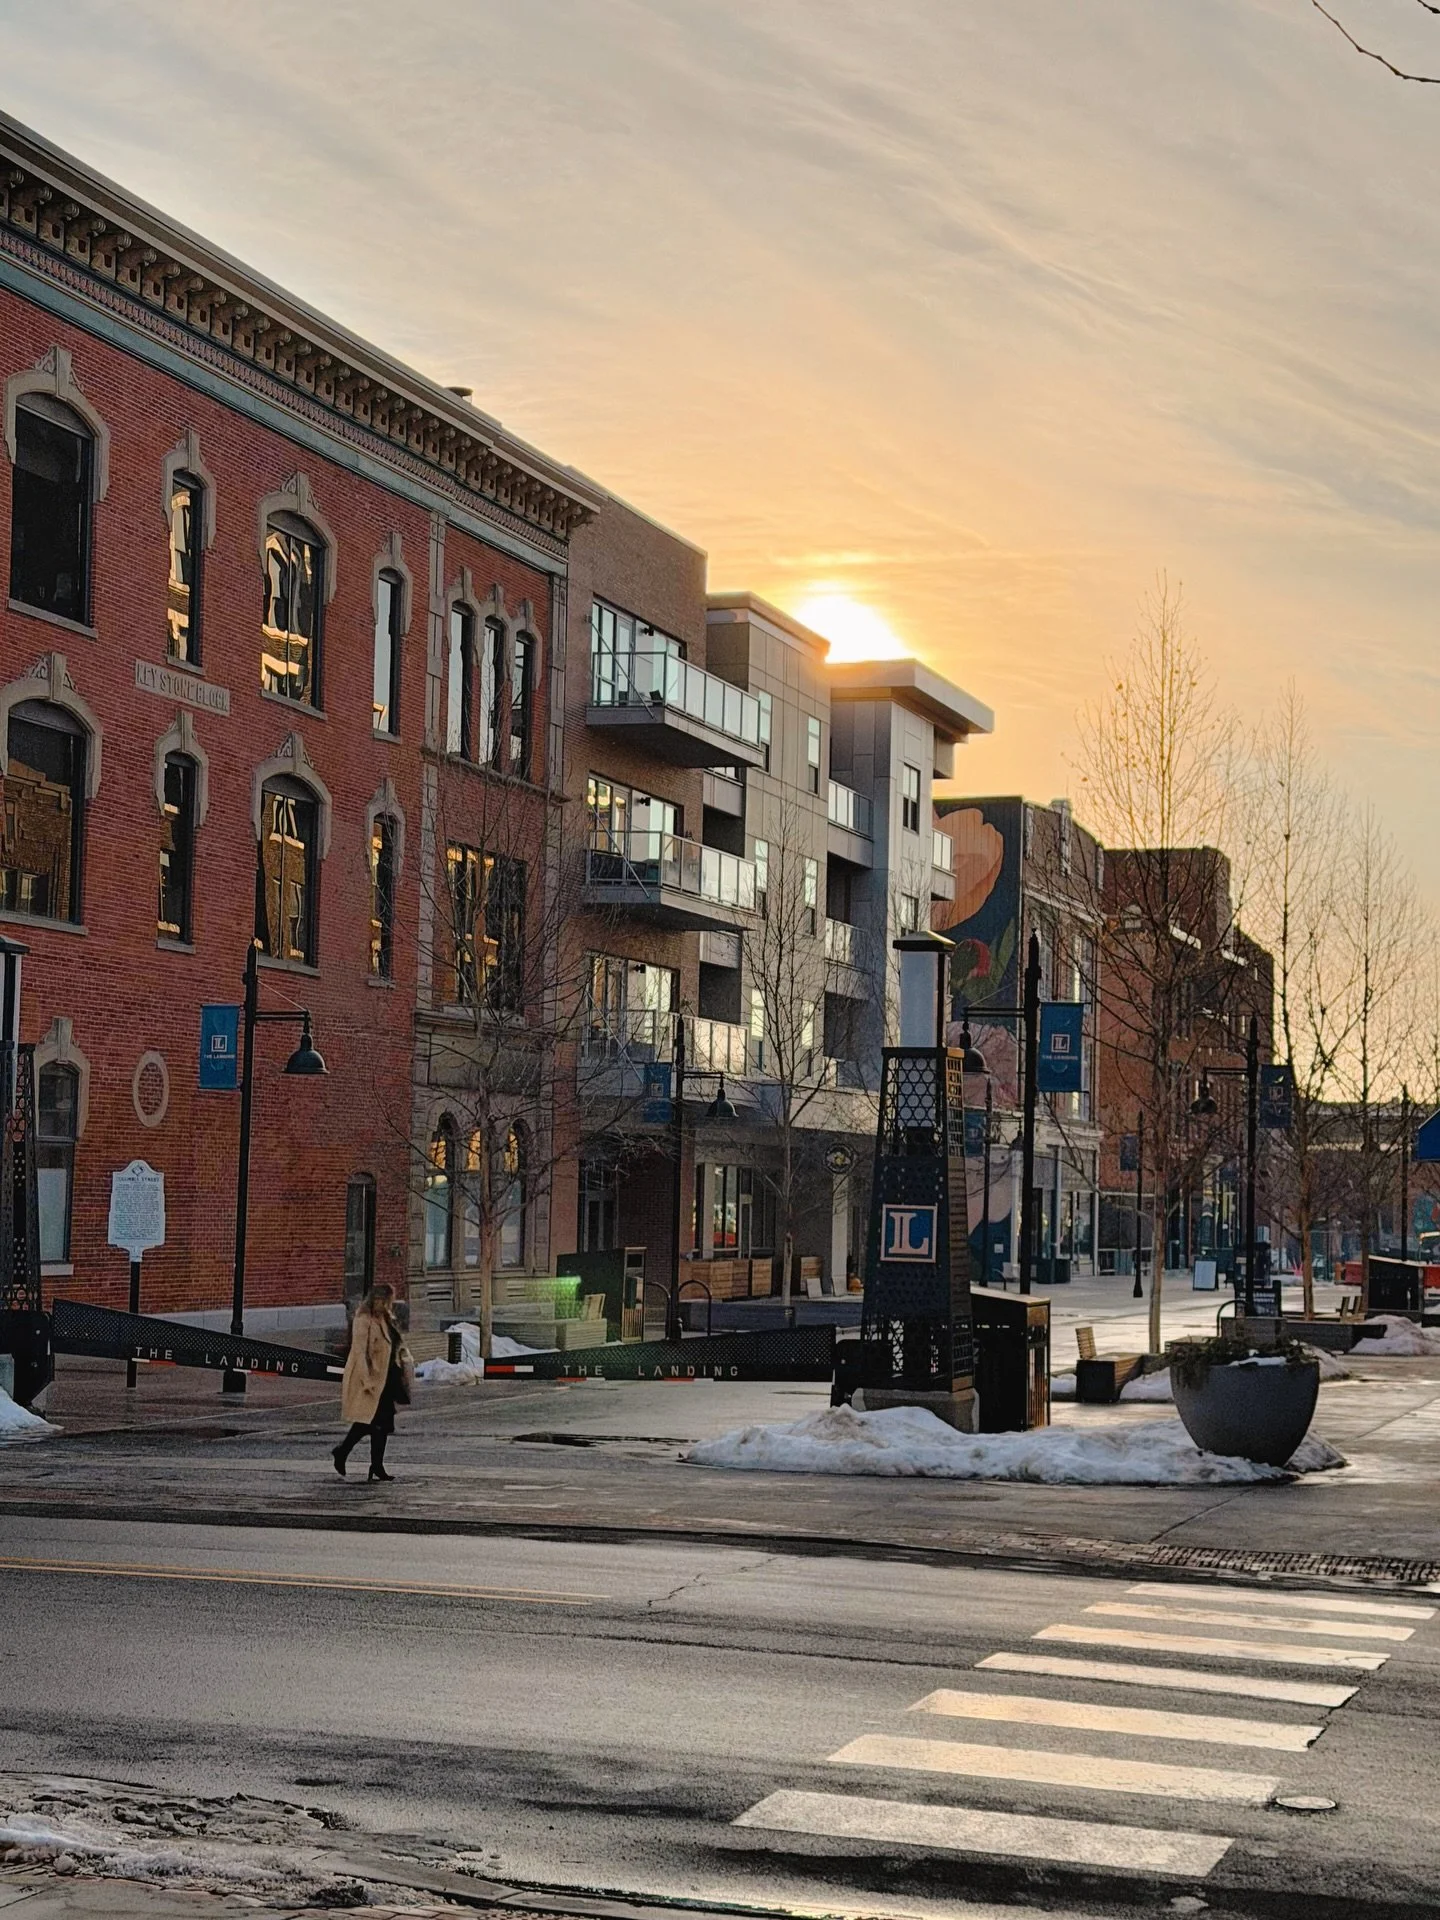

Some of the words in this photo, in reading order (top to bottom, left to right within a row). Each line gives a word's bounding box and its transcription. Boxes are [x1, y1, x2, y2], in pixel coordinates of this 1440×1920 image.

[136, 1346, 173, 1360] THE
[205, 1354, 299, 1373] LANDING
[563, 1365, 603, 1376] THE
[638, 1365, 739, 1377] LANDING
